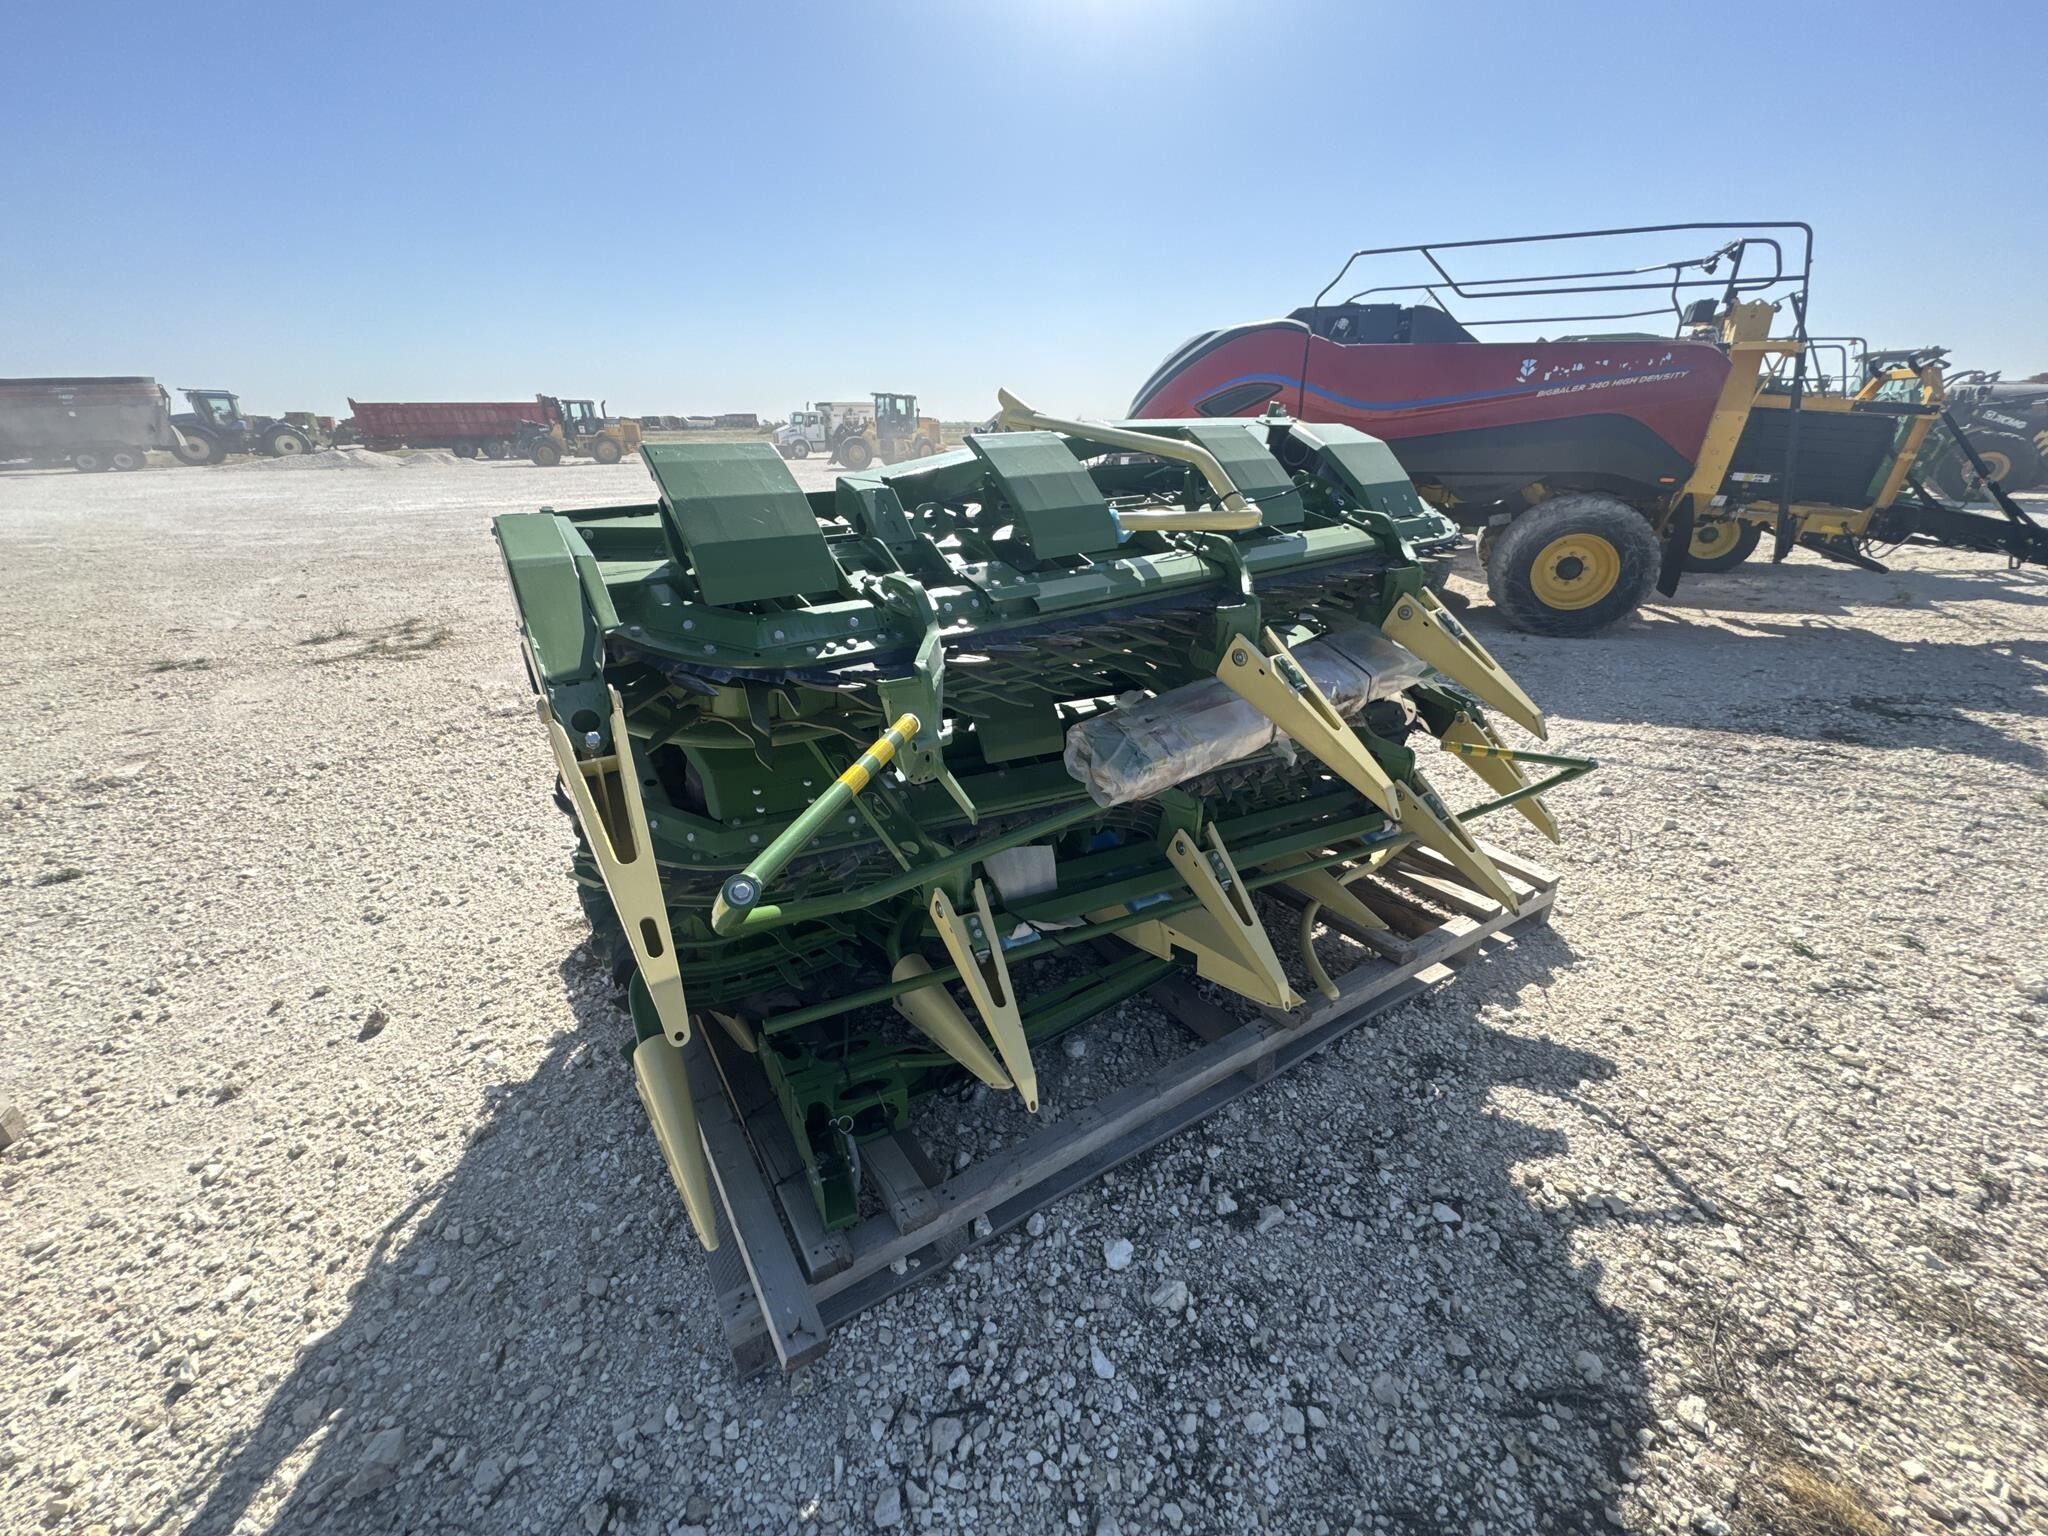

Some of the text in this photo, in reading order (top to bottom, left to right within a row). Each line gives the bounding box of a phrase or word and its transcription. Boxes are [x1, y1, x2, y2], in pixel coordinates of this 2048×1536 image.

[1536, 371, 1689, 397] BIGBALER 340 HIGH DENSITY
